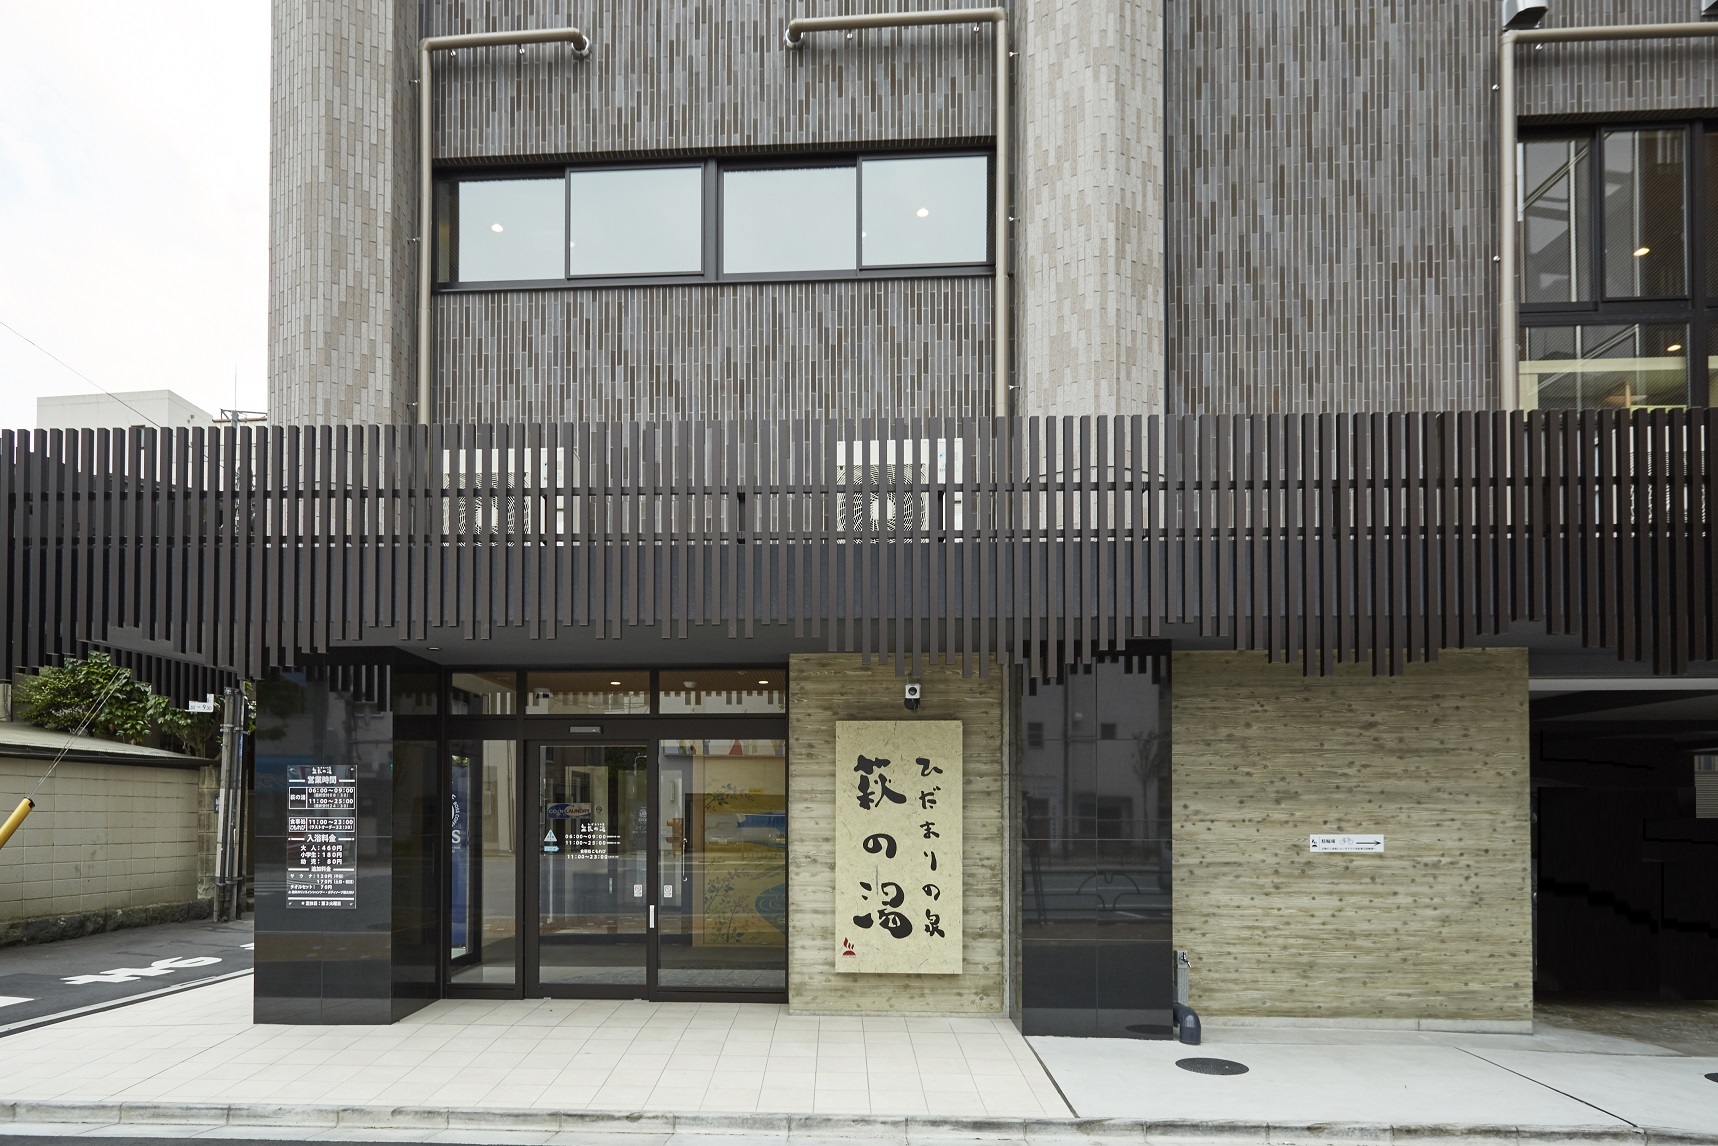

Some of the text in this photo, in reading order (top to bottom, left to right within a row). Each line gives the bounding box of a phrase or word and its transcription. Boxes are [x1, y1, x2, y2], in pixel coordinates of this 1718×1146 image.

[308, 776, 336, 784] 営業時間
[306, 834, 336, 842] 入浴料金
[854, 755, 912, 939] 萩の湯
[915, 757, 945, 938] ひだまりの泉
